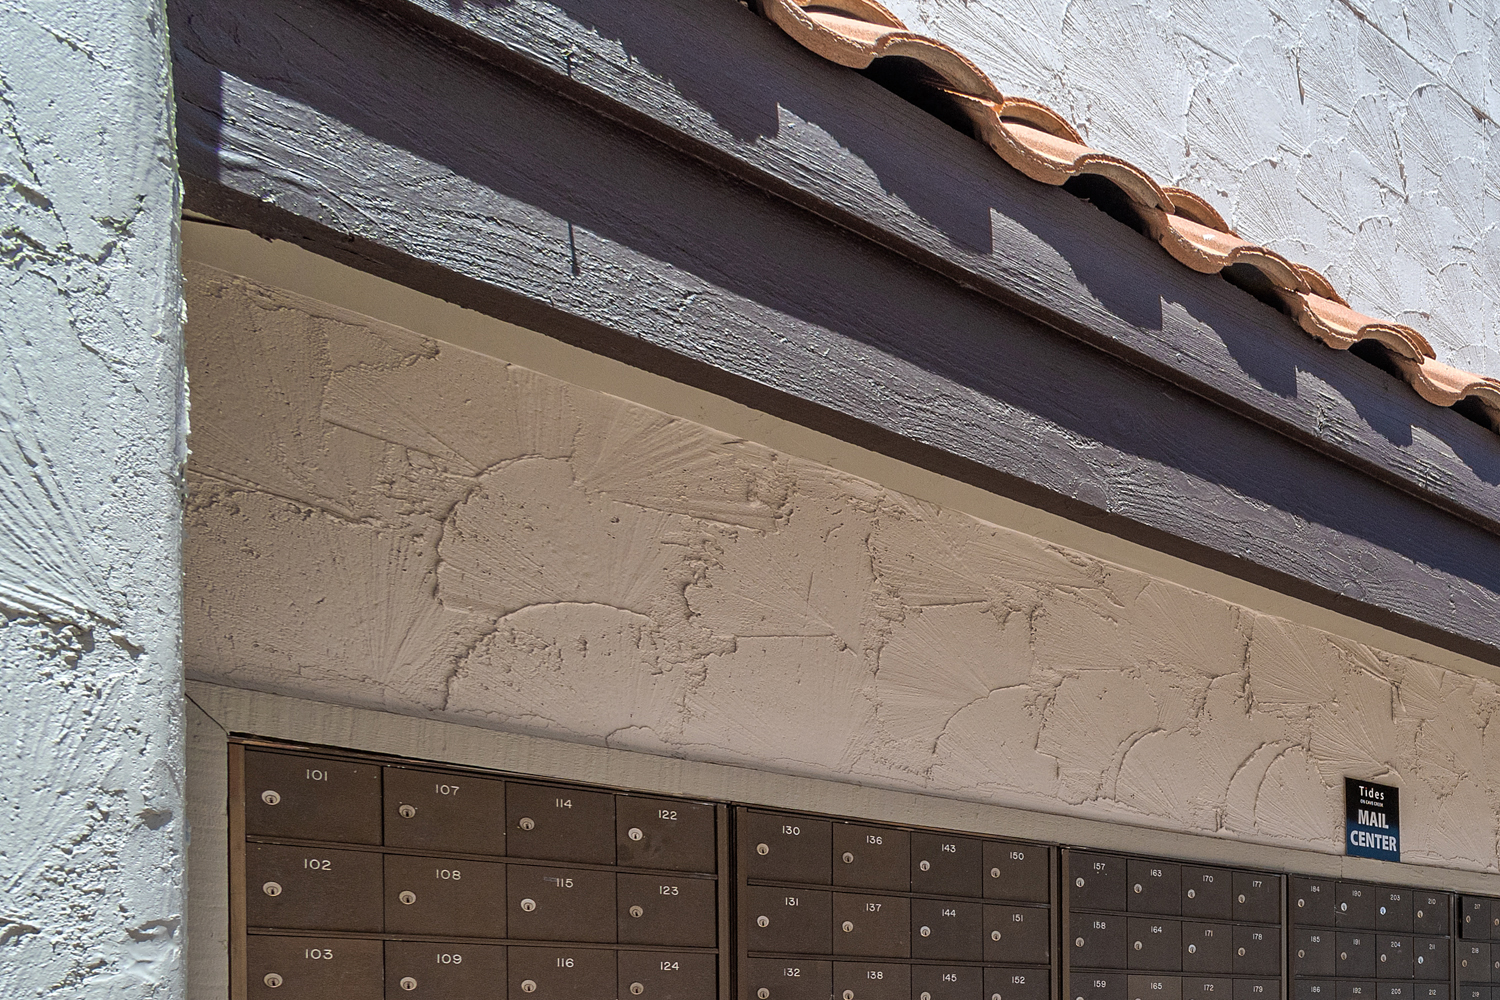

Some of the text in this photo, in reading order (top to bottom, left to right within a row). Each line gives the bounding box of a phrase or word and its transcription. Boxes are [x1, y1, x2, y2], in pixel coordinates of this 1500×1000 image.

[306, 768, 328, 782] 101
[435, 784, 460, 796] 107
[1358, 785, 1385, 801] Tides
[555, 798, 573, 809] 114
[658, 809, 678, 821] 122
[1358, 808, 1389, 830] MAIL
[782, 825, 801, 836] 130
[866, 835, 883, 845] 136
[1350, 829, 1397, 852] CENTER
[941, 843, 957, 853] 143
[1009, 851, 1025, 861] 150
[304, 858, 332, 871] 102
[1093, 862, 1106, 871] 157
[436, 869, 462, 881] 108
[1150, 869, 1163, 878] 163
[1202, 874, 1214, 883] 170
[556, 877, 574, 889] 115
[1252, 880, 1263, 888] 177
[659, 885, 679, 896] 123
[1310, 885, 1321, 893] 184
[785, 896, 799, 907] 131
[1389, 893, 1401, 902] 203
[866, 902, 882, 912] 137
[941, 908, 957, 918] 144
[1012, 913, 1024, 922] 151
[1093, 921, 1106, 930] 158
[1150, 925, 1163, 934] 164
[1204, 929, 1214, 938] 171
[1252, 933, 1263, 941] 178
[1310, 935, 1321, 943] 185
[1390, 940, 1401, 948] 204
[305, 948, 334, 960] 103
[436, 953, 463, 965] 109
[557, 957, 575, 968] 116
[660, 961, 680, 971] 124
[783, 967, 801, 977] 132
[867, 970, 884, 980] 138
[942, 973, 958, 983] 145
[1011, 975, 1026, 985] 152
[1093, 979, 1107, 988] 159
[1150, 982, 1163, 990] 165
[1203, 983, 1215, 992] 172
[1252, 985, 1264, 993] 179
[1310, 985, 1321, 993] 186
[1352, 987, 1362, 995] 192
[1428, 988, 1437, 996] 212
